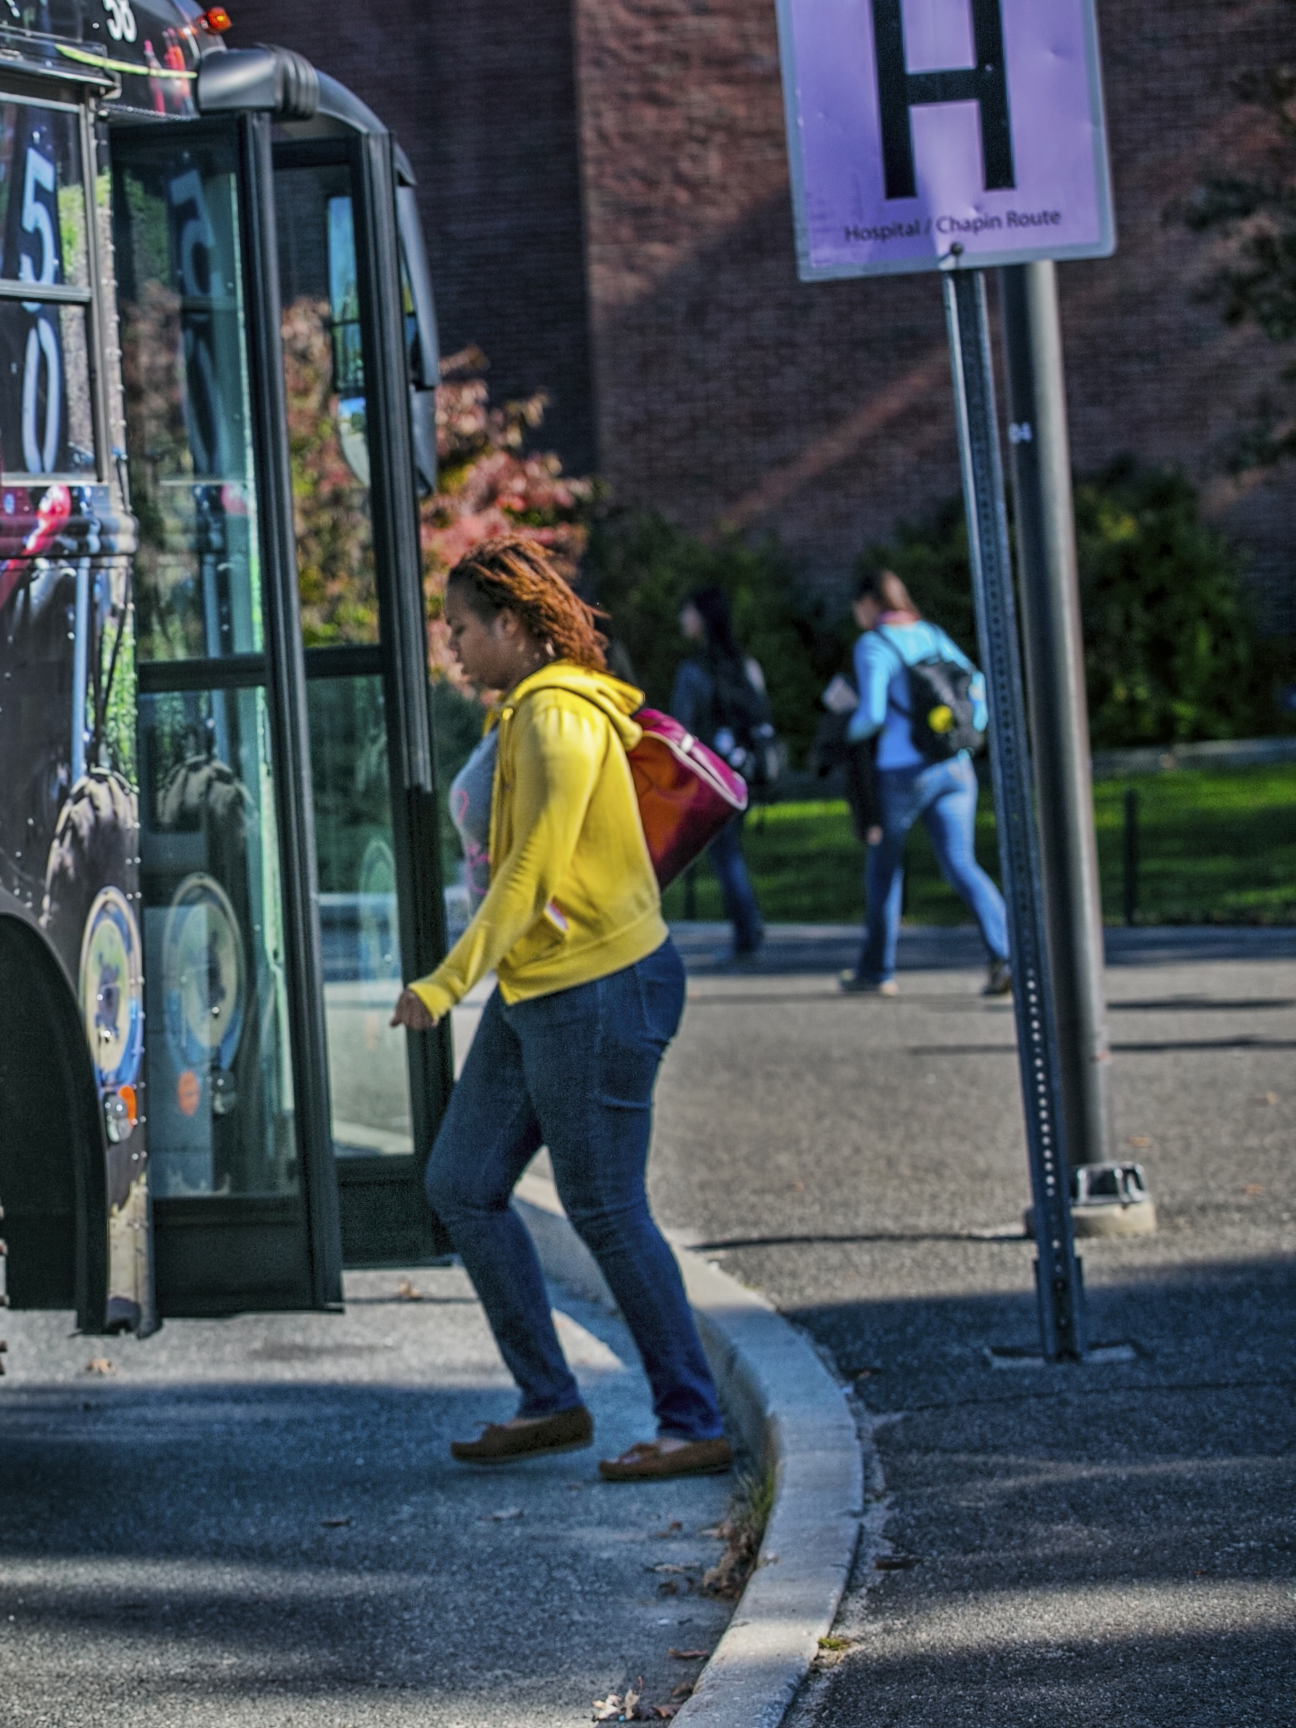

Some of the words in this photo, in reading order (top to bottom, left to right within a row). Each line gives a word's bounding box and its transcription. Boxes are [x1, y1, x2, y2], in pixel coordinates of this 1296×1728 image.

[871, 0, 1016, 200] H
[844, 219, 921, 243] Hospital
[936, 213, 1003, 235] Chapin
[1006, 209, 1062, 229] Route
